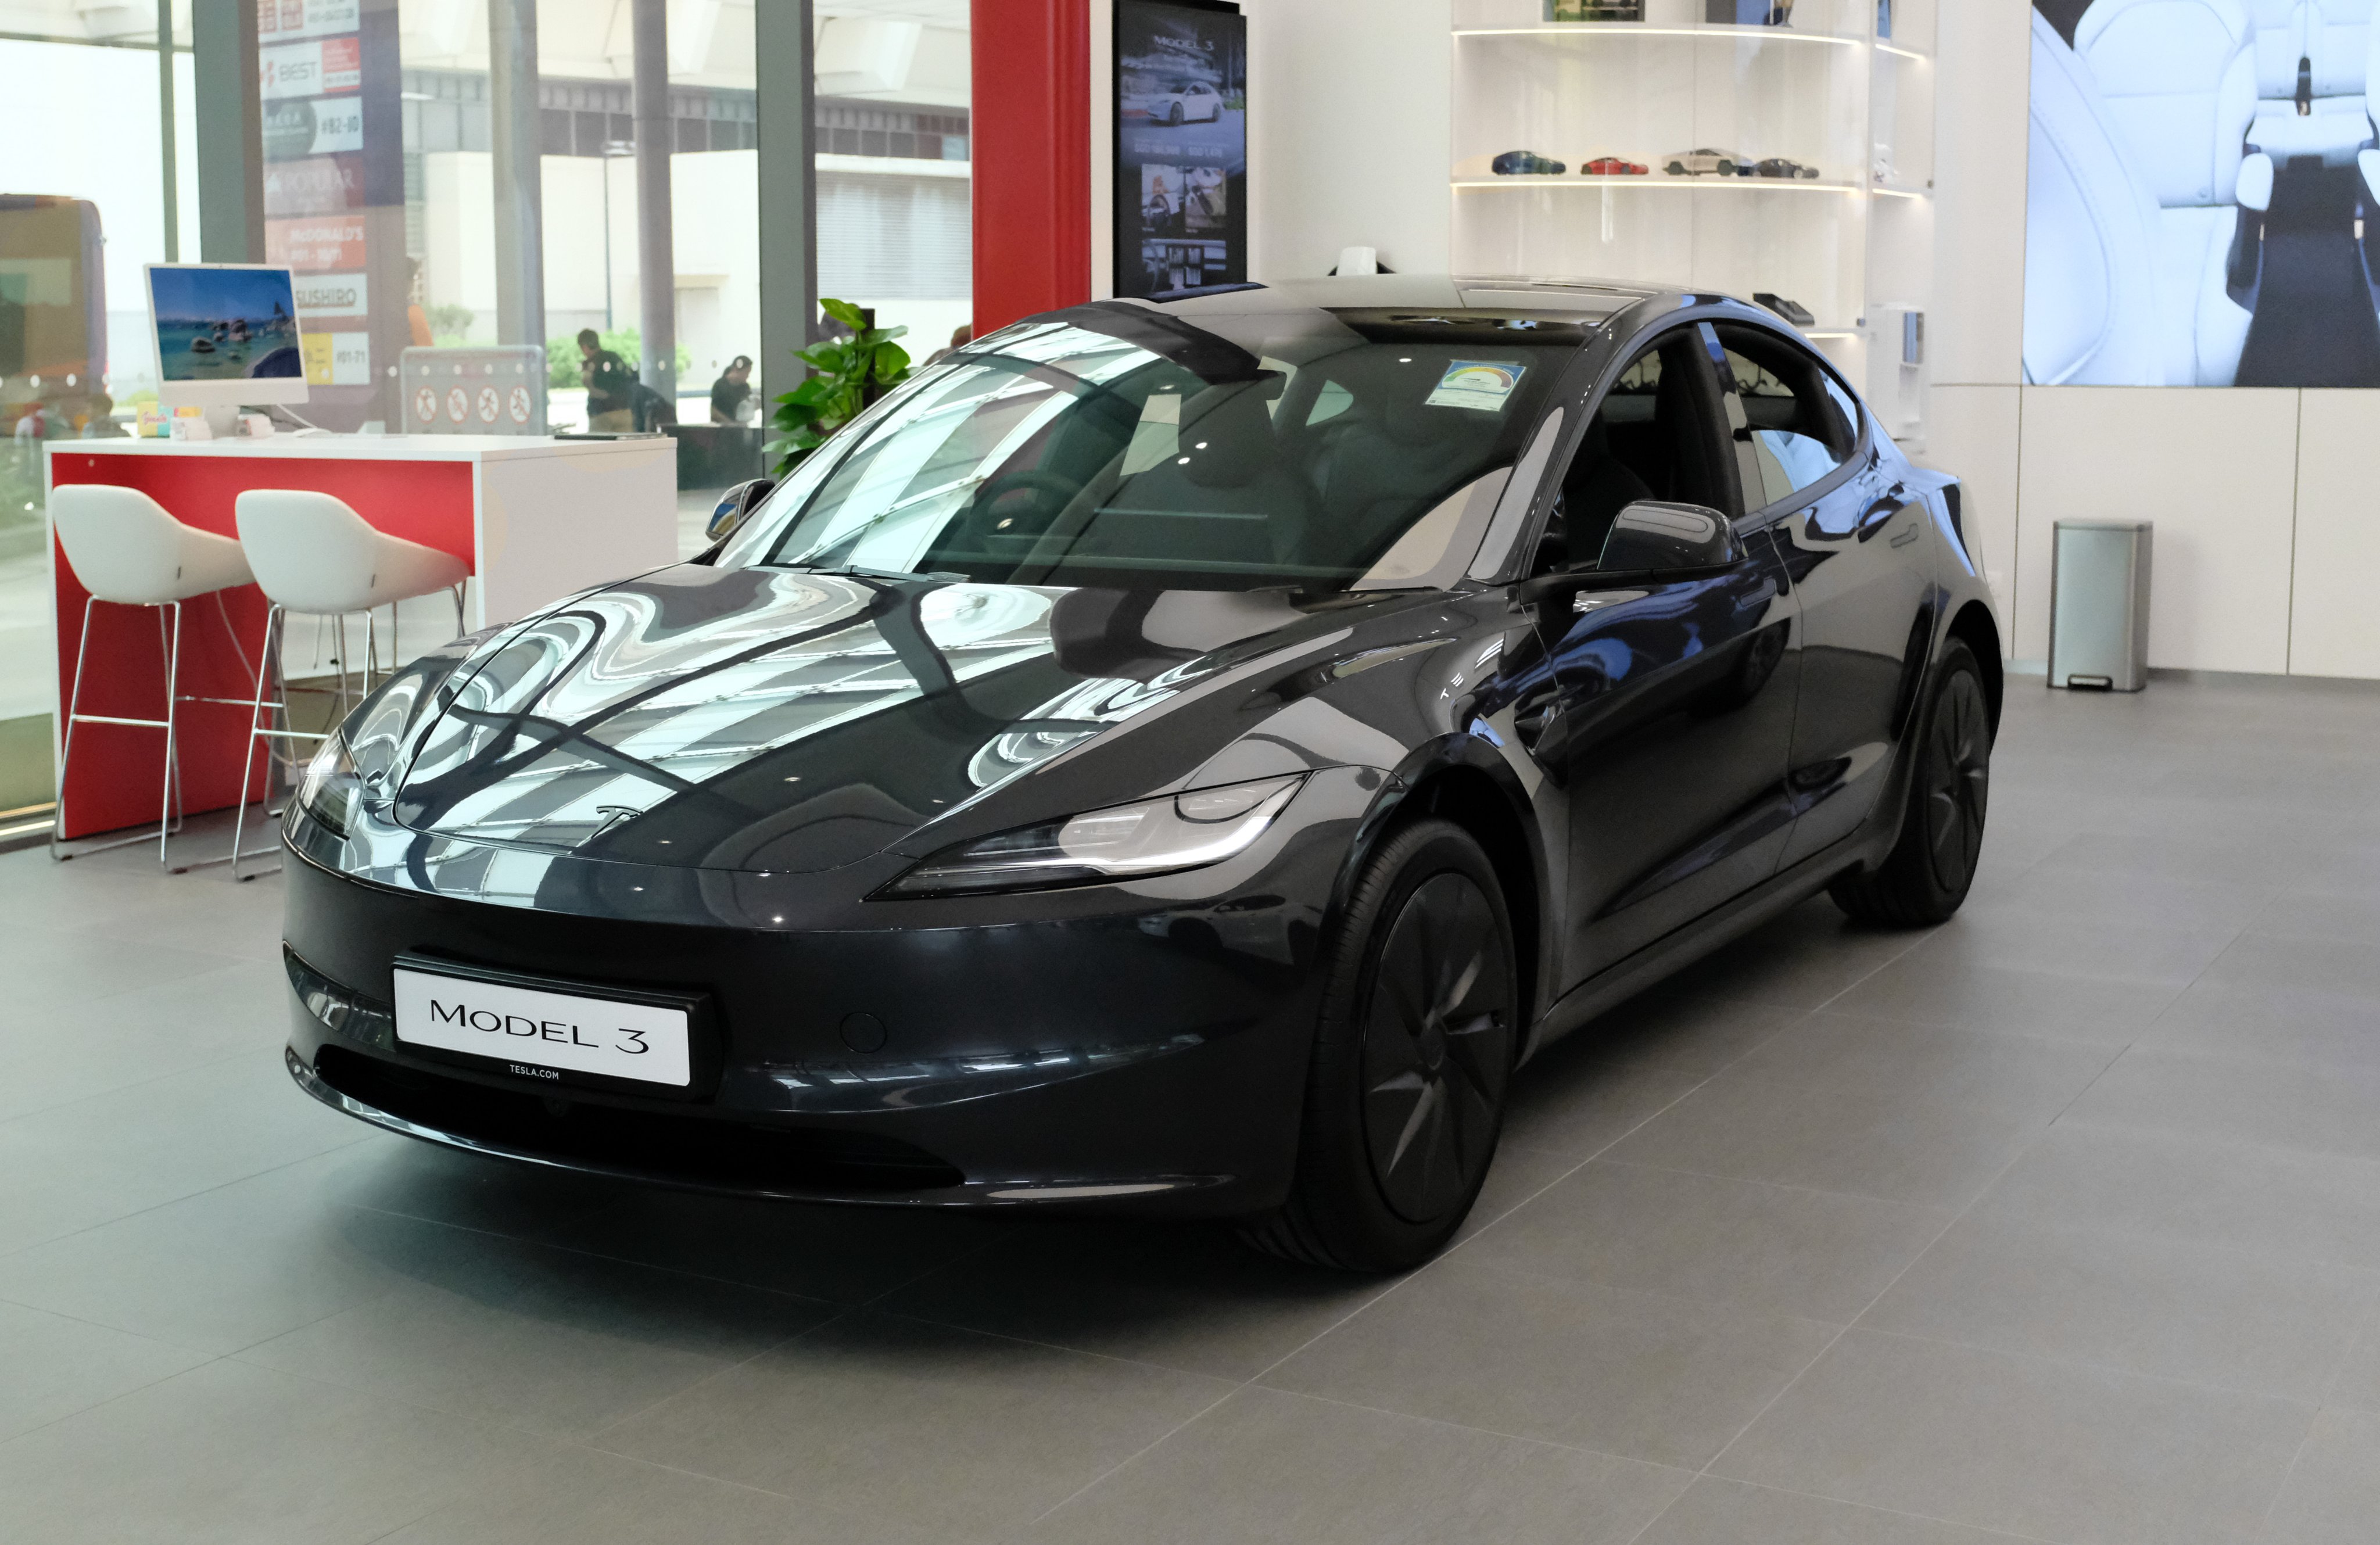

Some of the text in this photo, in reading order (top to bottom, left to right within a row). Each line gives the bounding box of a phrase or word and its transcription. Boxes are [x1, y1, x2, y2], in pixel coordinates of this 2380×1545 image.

[1153, 35, 1215, 51] MODEL 3
[279, 61, 317, 82] BEST
[296, 288, 357, 306] SUSHIRO
[430, 999, 650, 1055] MODEL 3
[509, 1064, 560, 1080] TESLA.COM
